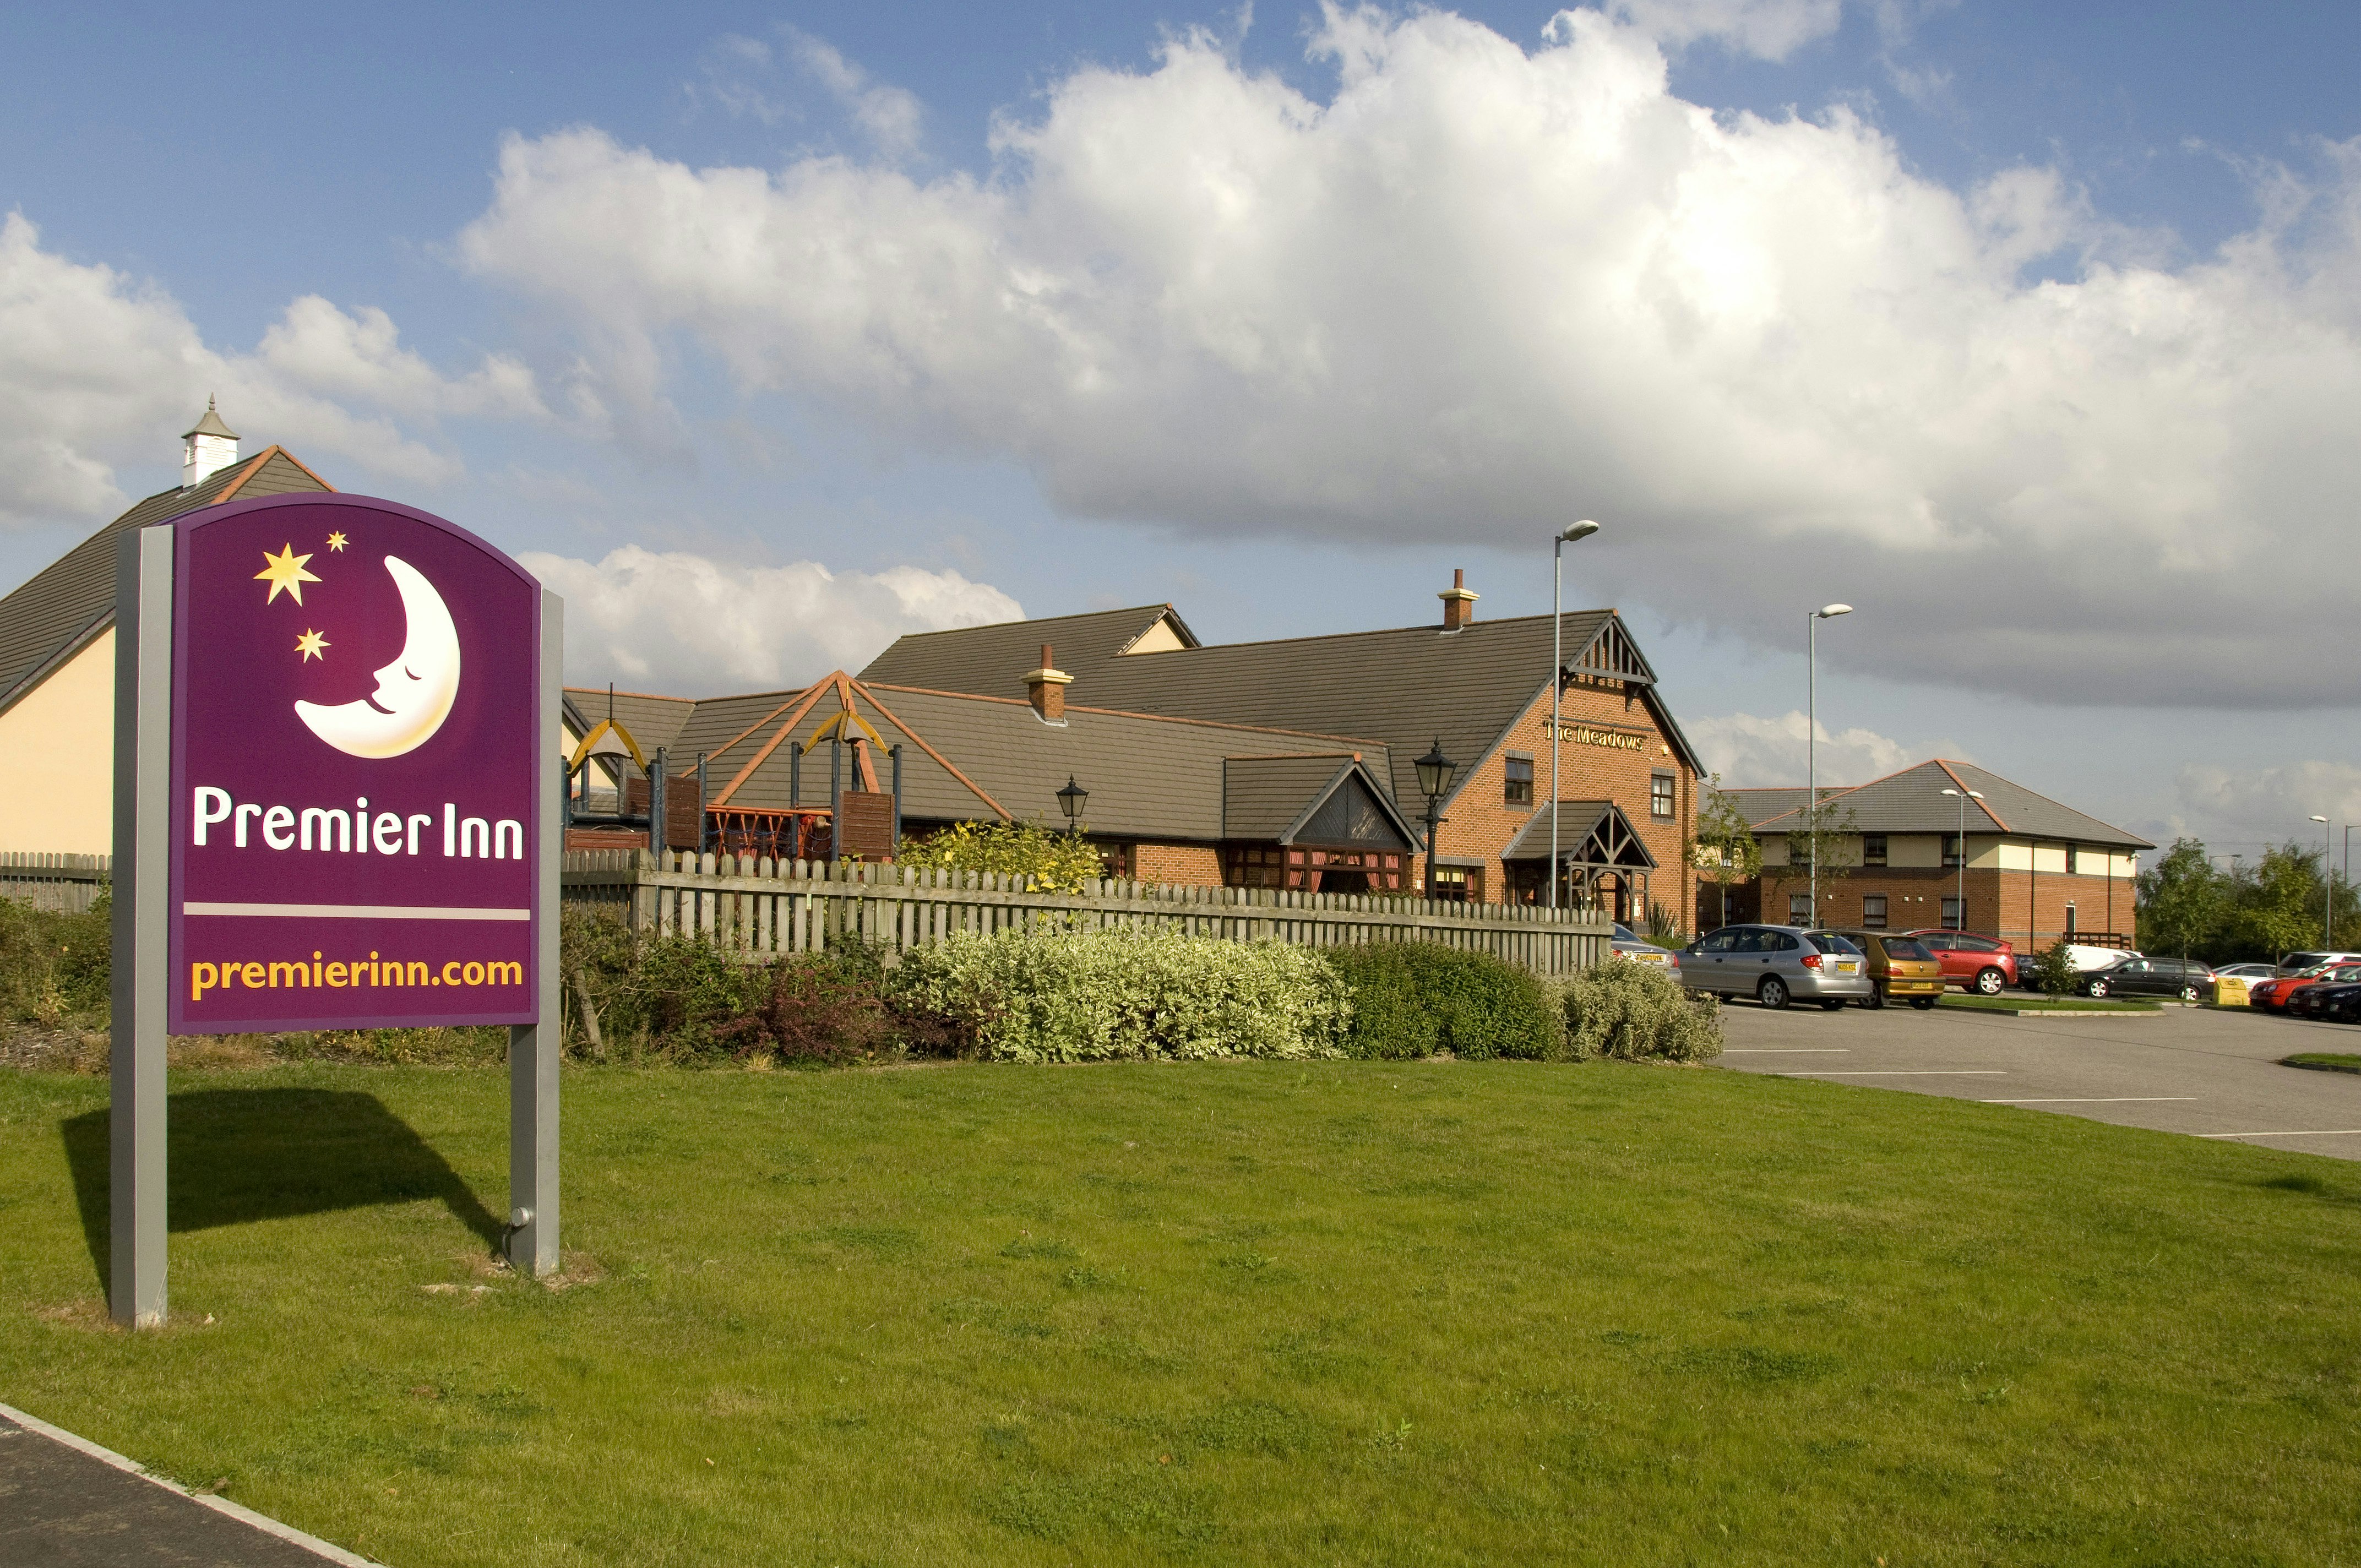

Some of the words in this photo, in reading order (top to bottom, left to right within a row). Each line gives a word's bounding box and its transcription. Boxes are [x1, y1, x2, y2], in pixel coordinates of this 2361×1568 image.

[1576, 725, 1644, 751] Meadows
[193, 786, 432, 856] Premier
[444, 803, 523, 860] Inn
[192, 951, 522, 1001] premierinn.com
